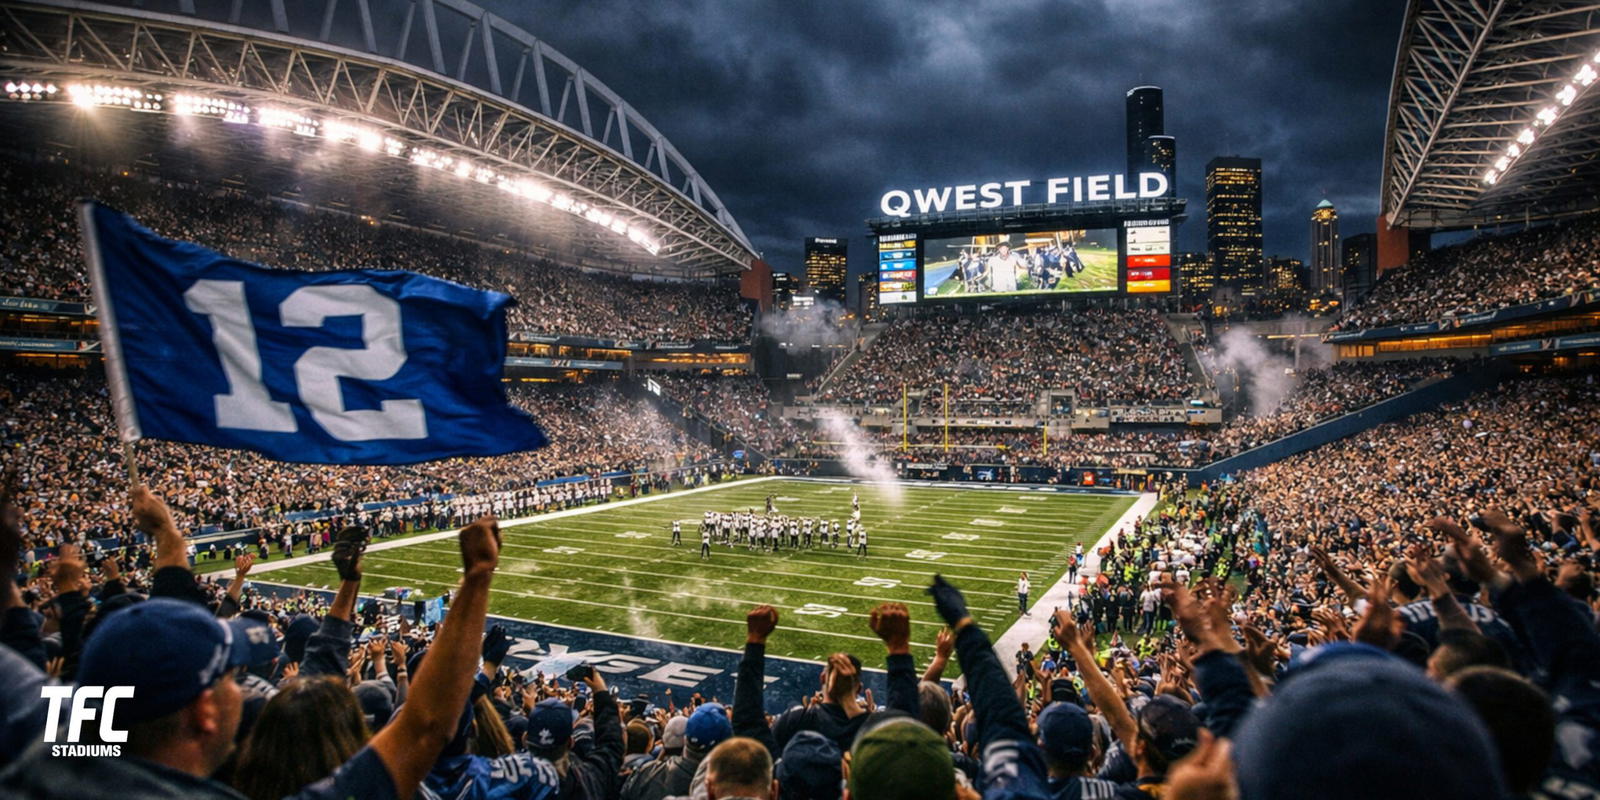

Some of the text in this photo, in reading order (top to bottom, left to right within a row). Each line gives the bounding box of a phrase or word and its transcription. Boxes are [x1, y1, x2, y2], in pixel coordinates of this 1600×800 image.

[880, 172, 1168, 217] QWEST FIELD
[183, 279, 428, 441] 12
